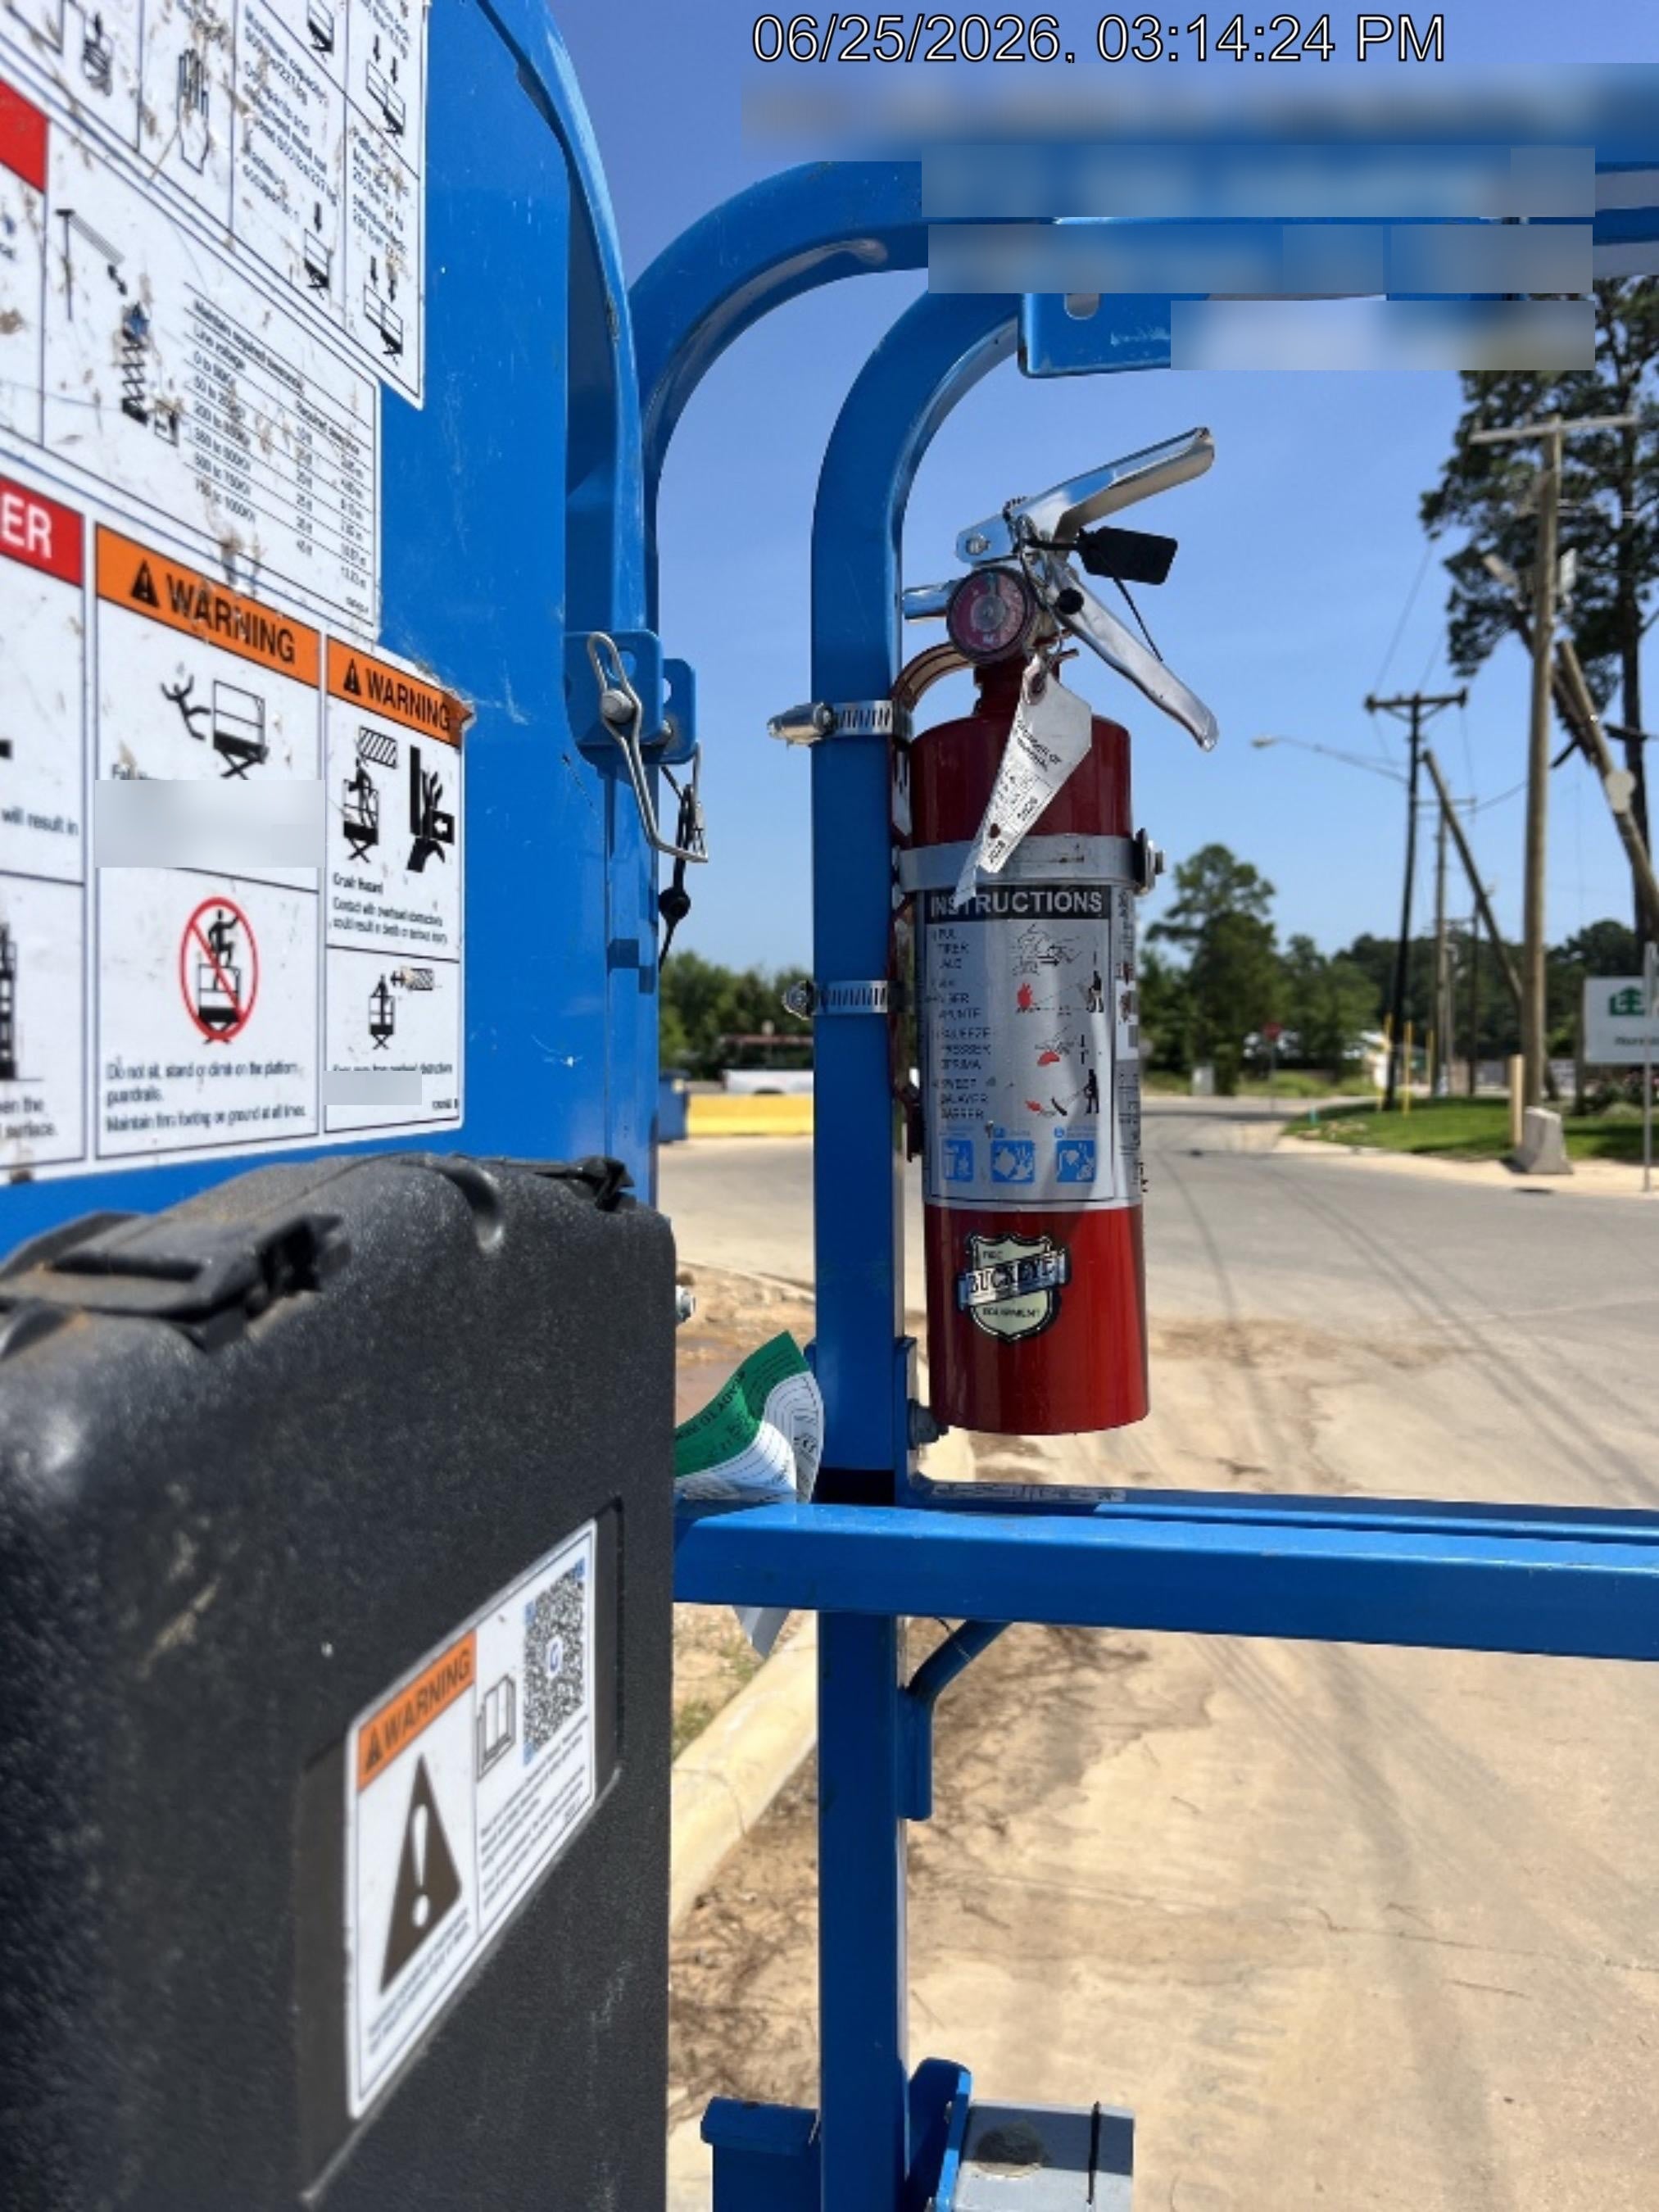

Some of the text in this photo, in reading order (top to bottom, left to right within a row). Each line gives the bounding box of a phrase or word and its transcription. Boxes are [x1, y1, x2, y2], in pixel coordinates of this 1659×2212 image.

[167, 573, 296, 665] WARNING
[365, 666, 451, 733] WARNING
[23, 1095, 44, 1114] the
[107, 1063, 125, 1080] Do
[127, 1063, 145, 1079] not
[383, 1648, 470, 1751] WARNING
